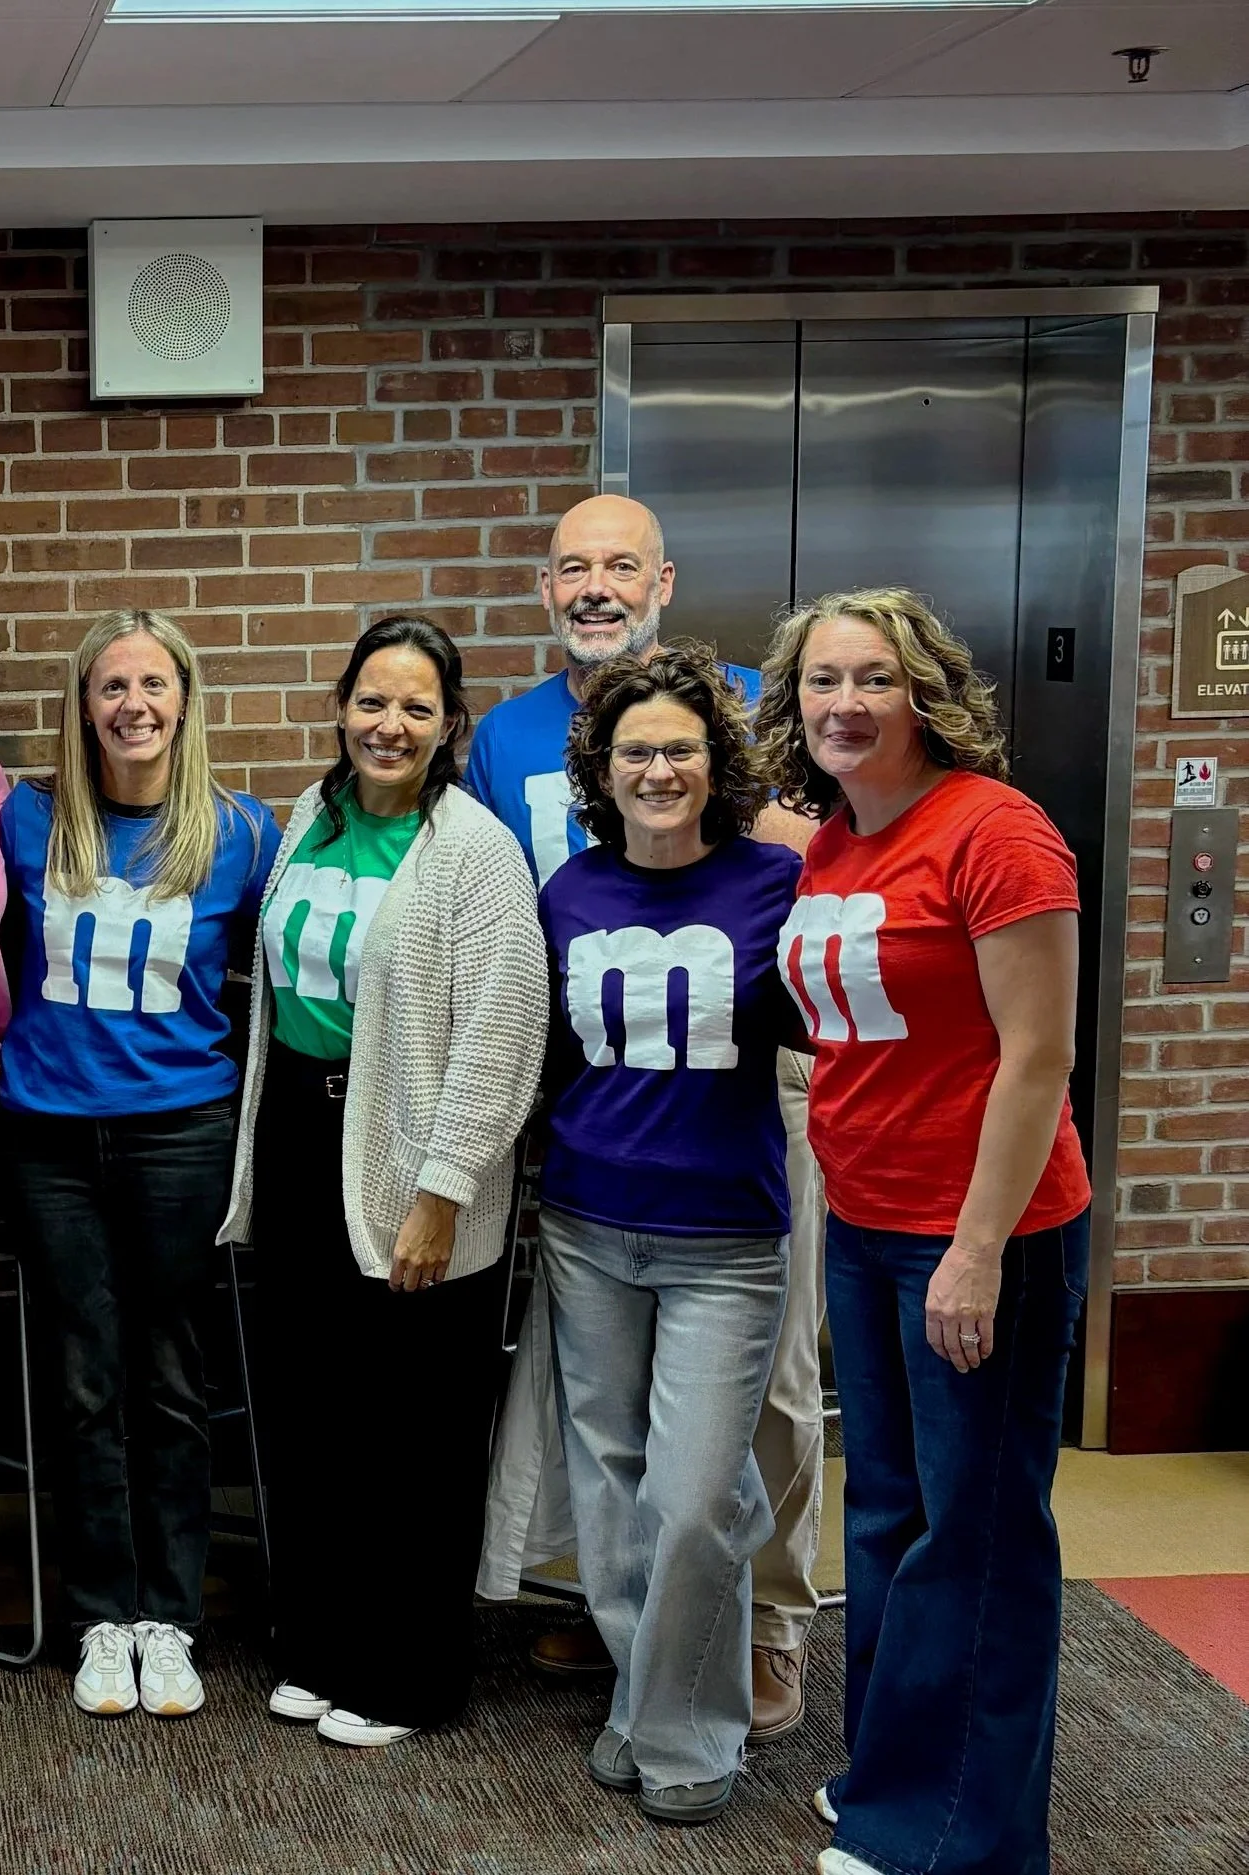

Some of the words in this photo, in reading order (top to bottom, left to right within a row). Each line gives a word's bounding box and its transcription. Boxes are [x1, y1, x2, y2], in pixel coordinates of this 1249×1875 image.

[1055, 635, 1064, 663] 3
[42, 870, 194, 1014] m
[567, 924, 739, 1070] m
[777, 892, 908, 1042] m
